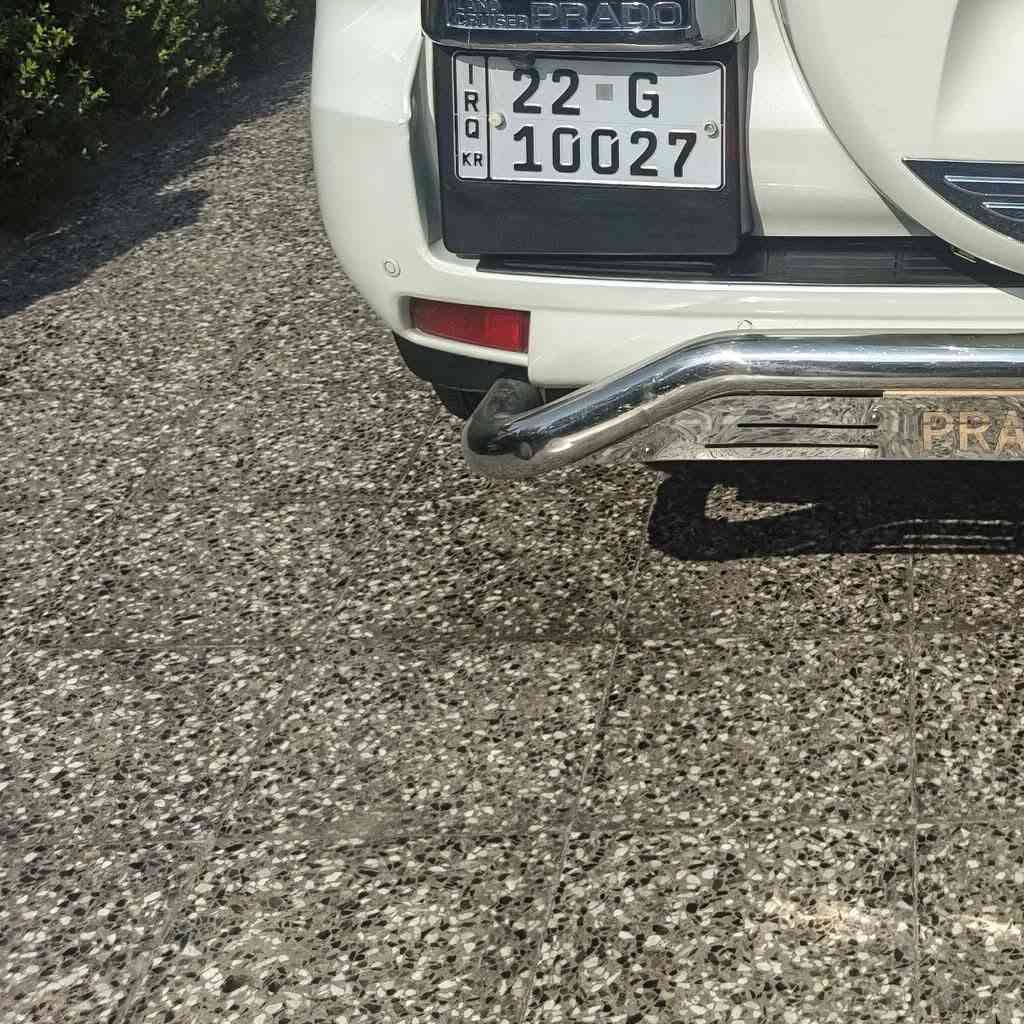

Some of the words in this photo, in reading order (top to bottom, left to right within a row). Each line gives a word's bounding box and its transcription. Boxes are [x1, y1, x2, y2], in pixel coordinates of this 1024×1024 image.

[530, 1, 682, 28] PRADO
[512, 68, 581, 116] 22
[628, 72, 661, 119] G
[462, 152, 483, 167] KR
[513, 126, 698, 178] 10027
